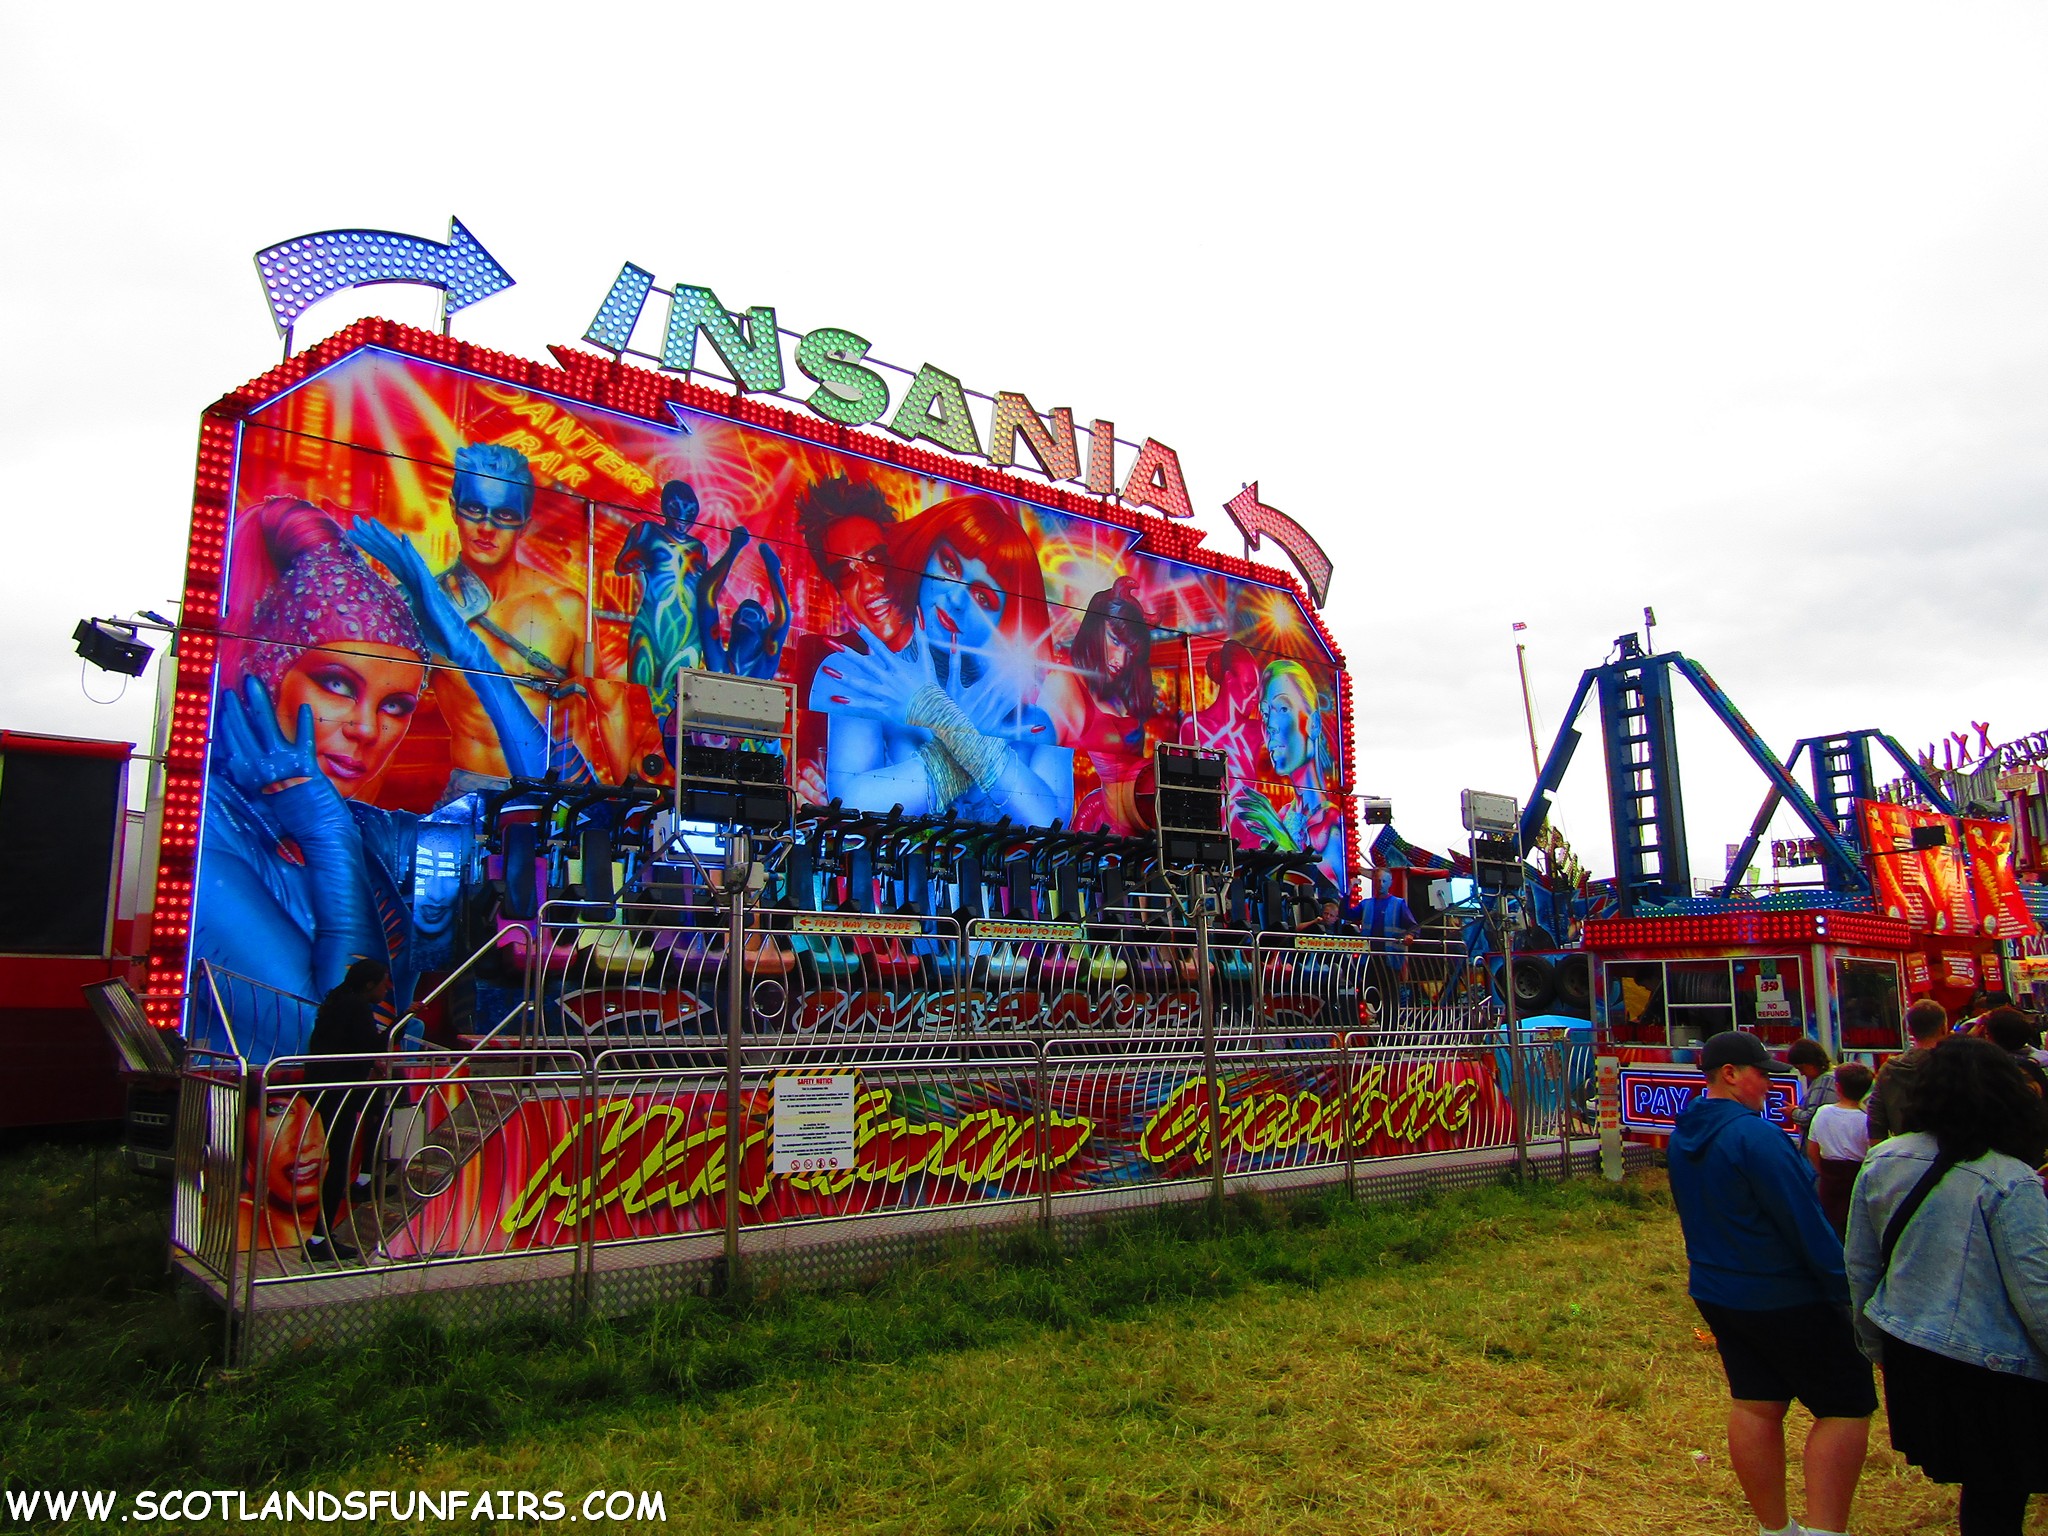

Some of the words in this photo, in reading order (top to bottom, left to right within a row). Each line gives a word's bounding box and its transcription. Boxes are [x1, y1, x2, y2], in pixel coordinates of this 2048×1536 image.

[581, 261, 1194, 518] INSANIA
[495, 429, 591, 488] BAR
[814, 919, 838, 928] THIS
[841, 920, 863, 929] WAY
[867, 921, 881, 930] TO
[884, 922, 912, 931] RIDE
[992, 926, 1014, 935] THIS
[1015, 927, 1035, 936] WAY
[1037, 928, 1049, 936] TO
[1051, 928, 1075, 937] RIDE
[1758, 1010, 1789, 1018] REFUNDS
[1634, 1084, 1689, 1116] PAY
